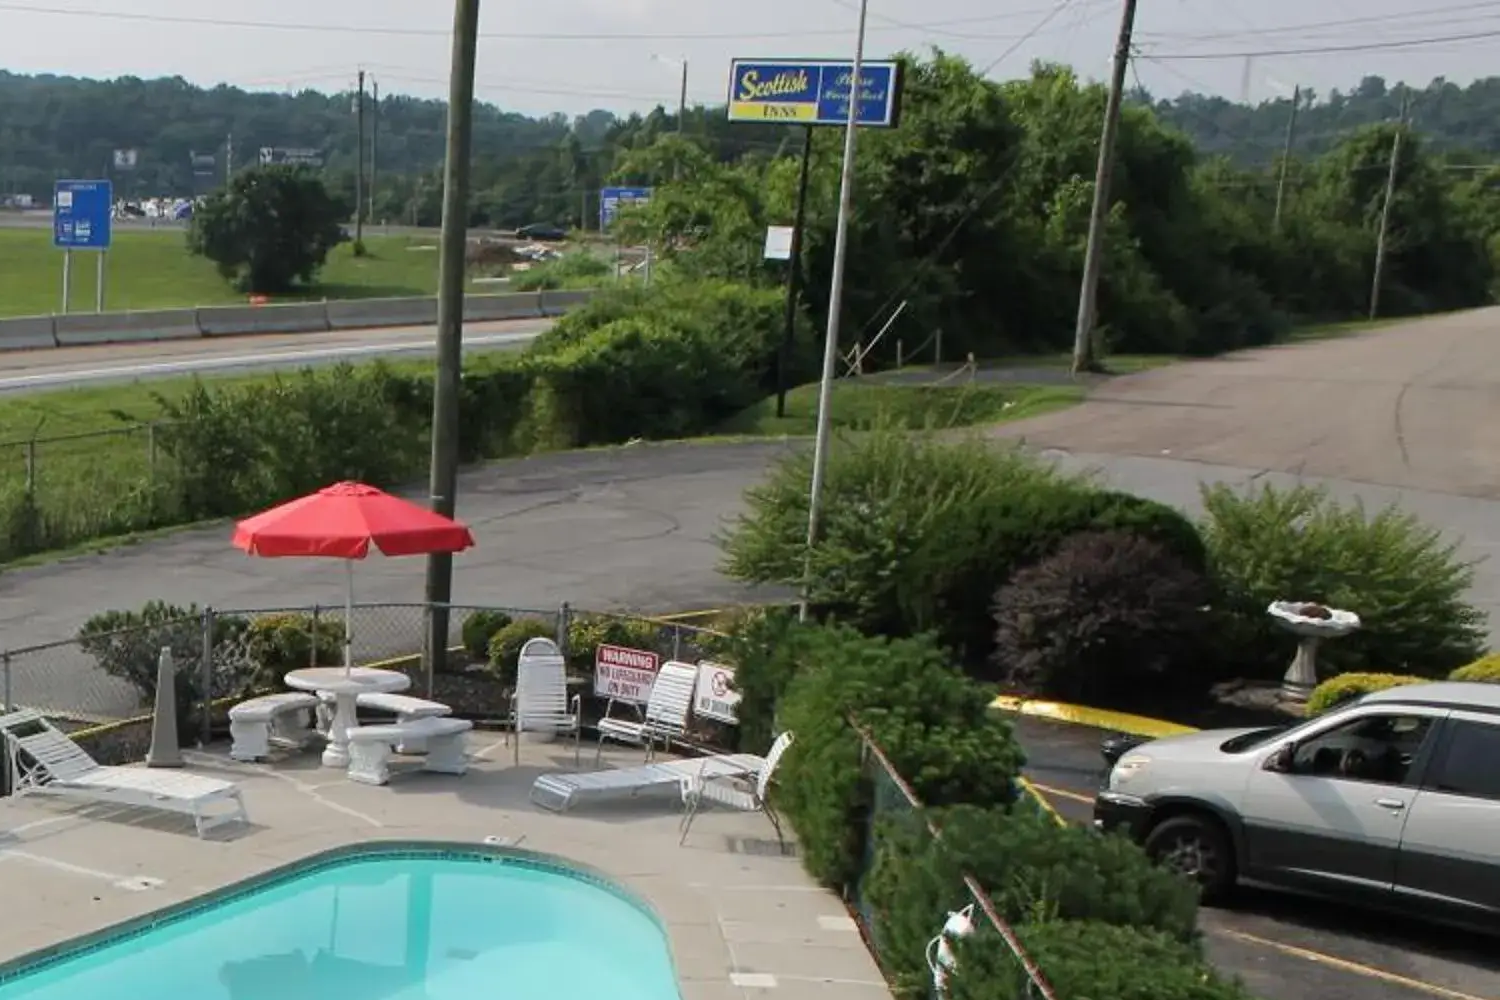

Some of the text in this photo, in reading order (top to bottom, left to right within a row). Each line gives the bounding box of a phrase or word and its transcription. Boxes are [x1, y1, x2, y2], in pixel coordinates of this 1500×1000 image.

[739, 69, 808, 100] Scottish
[603, 648, 653, 669] WARNING
[600, 666, 610, 678] NO
[608, 680, 641, 697] ON DUTY
